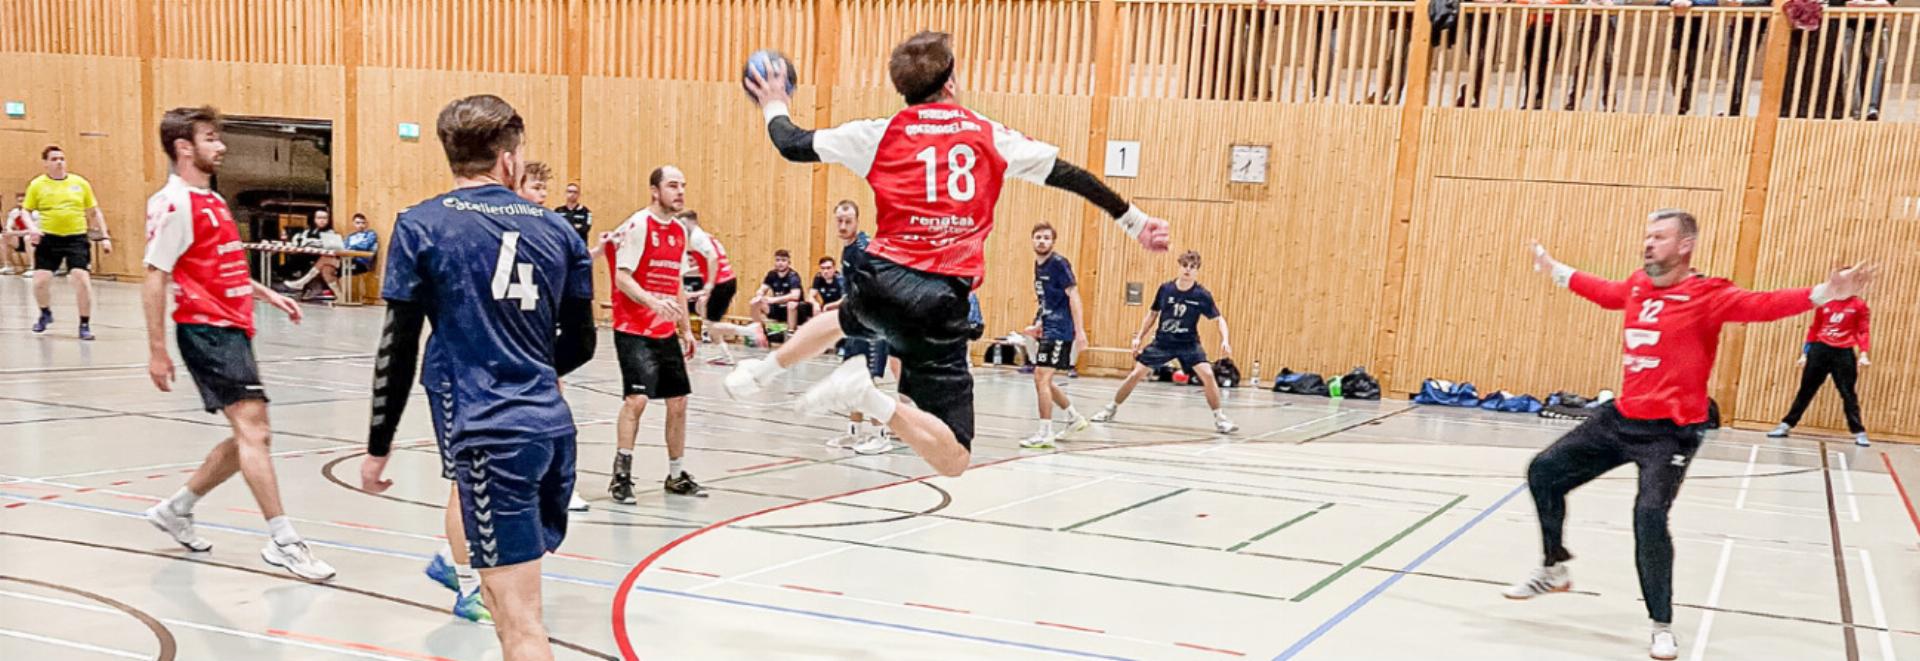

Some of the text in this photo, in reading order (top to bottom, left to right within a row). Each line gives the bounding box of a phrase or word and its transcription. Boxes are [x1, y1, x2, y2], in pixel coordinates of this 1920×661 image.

[1119, 147, 1126, 170] 1
[915, 143, 976, 203] 18
[491, 231, 540, 311] 4
[1173, 302, 1188, 318] 19
[1638, 298, 1665, 323] 12
